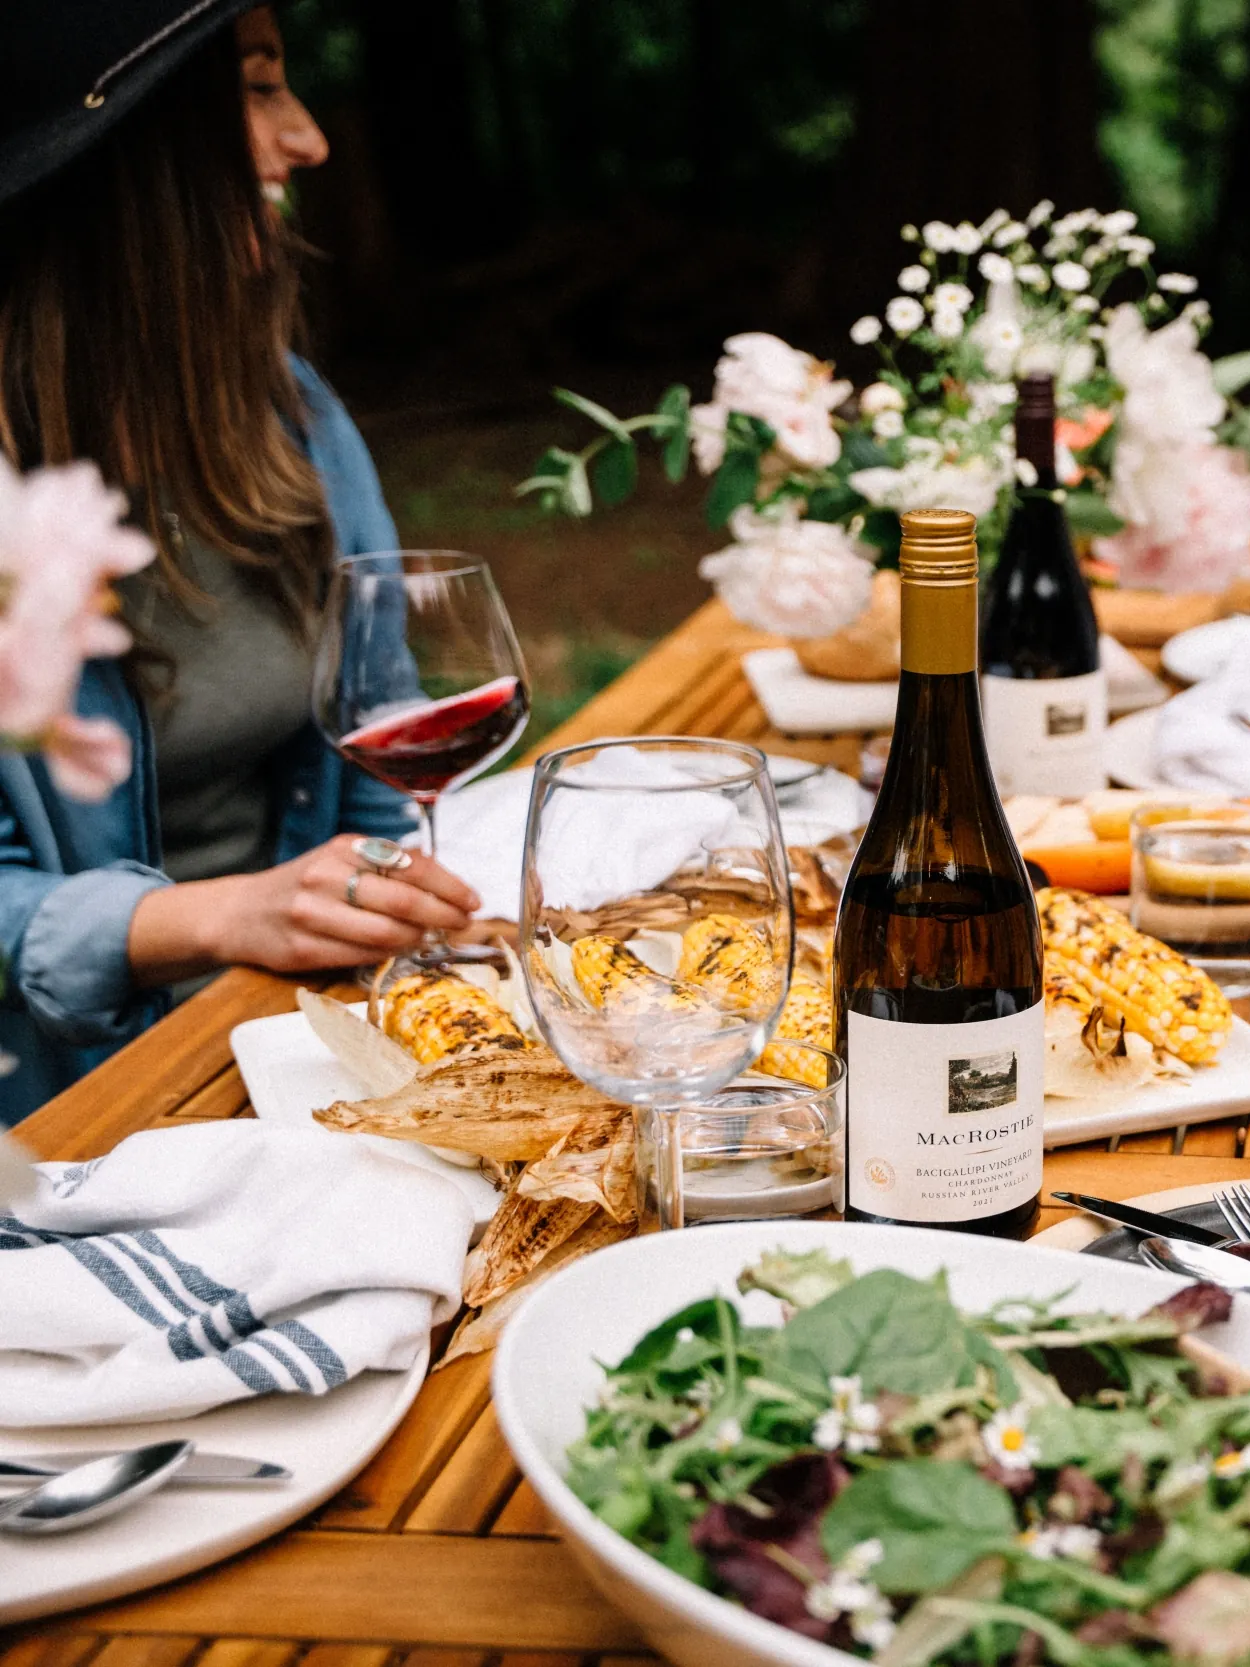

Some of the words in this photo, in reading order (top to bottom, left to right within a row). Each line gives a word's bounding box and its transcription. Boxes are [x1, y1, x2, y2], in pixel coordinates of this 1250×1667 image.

[916, 1164, 986, 1177] BACIGALUPI
[988, 1148, 1032, 1171] VINEYARD
[921, 1191, 966, 1199] RUSSIAN
[971, 1185, 1000, 1196] RIVER
[1003, 1172, 1030, 1189] VALLEY
[948, 1170, 1013, 1188] CHARDONNAY
